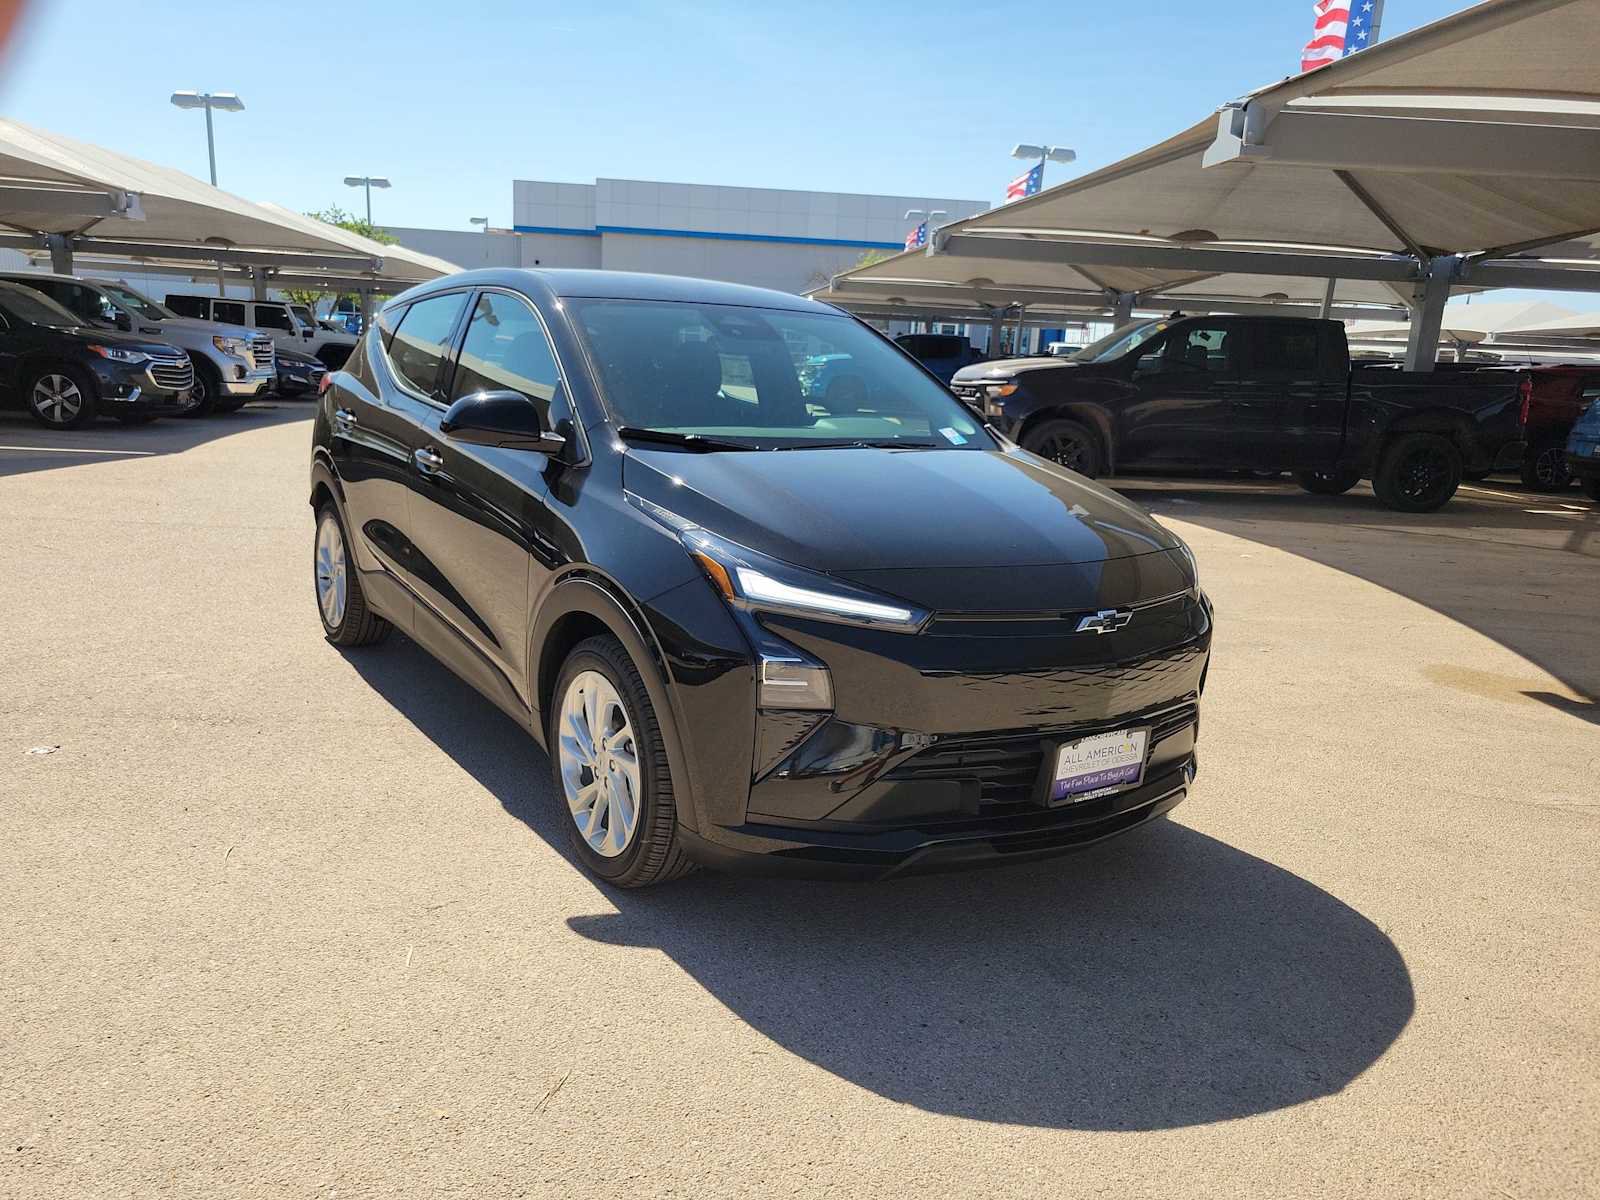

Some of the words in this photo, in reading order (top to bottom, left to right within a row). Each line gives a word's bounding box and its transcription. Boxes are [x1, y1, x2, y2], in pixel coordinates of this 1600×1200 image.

[1062, 761, 1100, 774] CHEVROLET
[1111, 753, 1138, 764] ODESSA
[1064, 754, 1083, 765] ALL
[1084, 774, 1099, 785] Place
[1107, 771, 1118, 782] Buy
